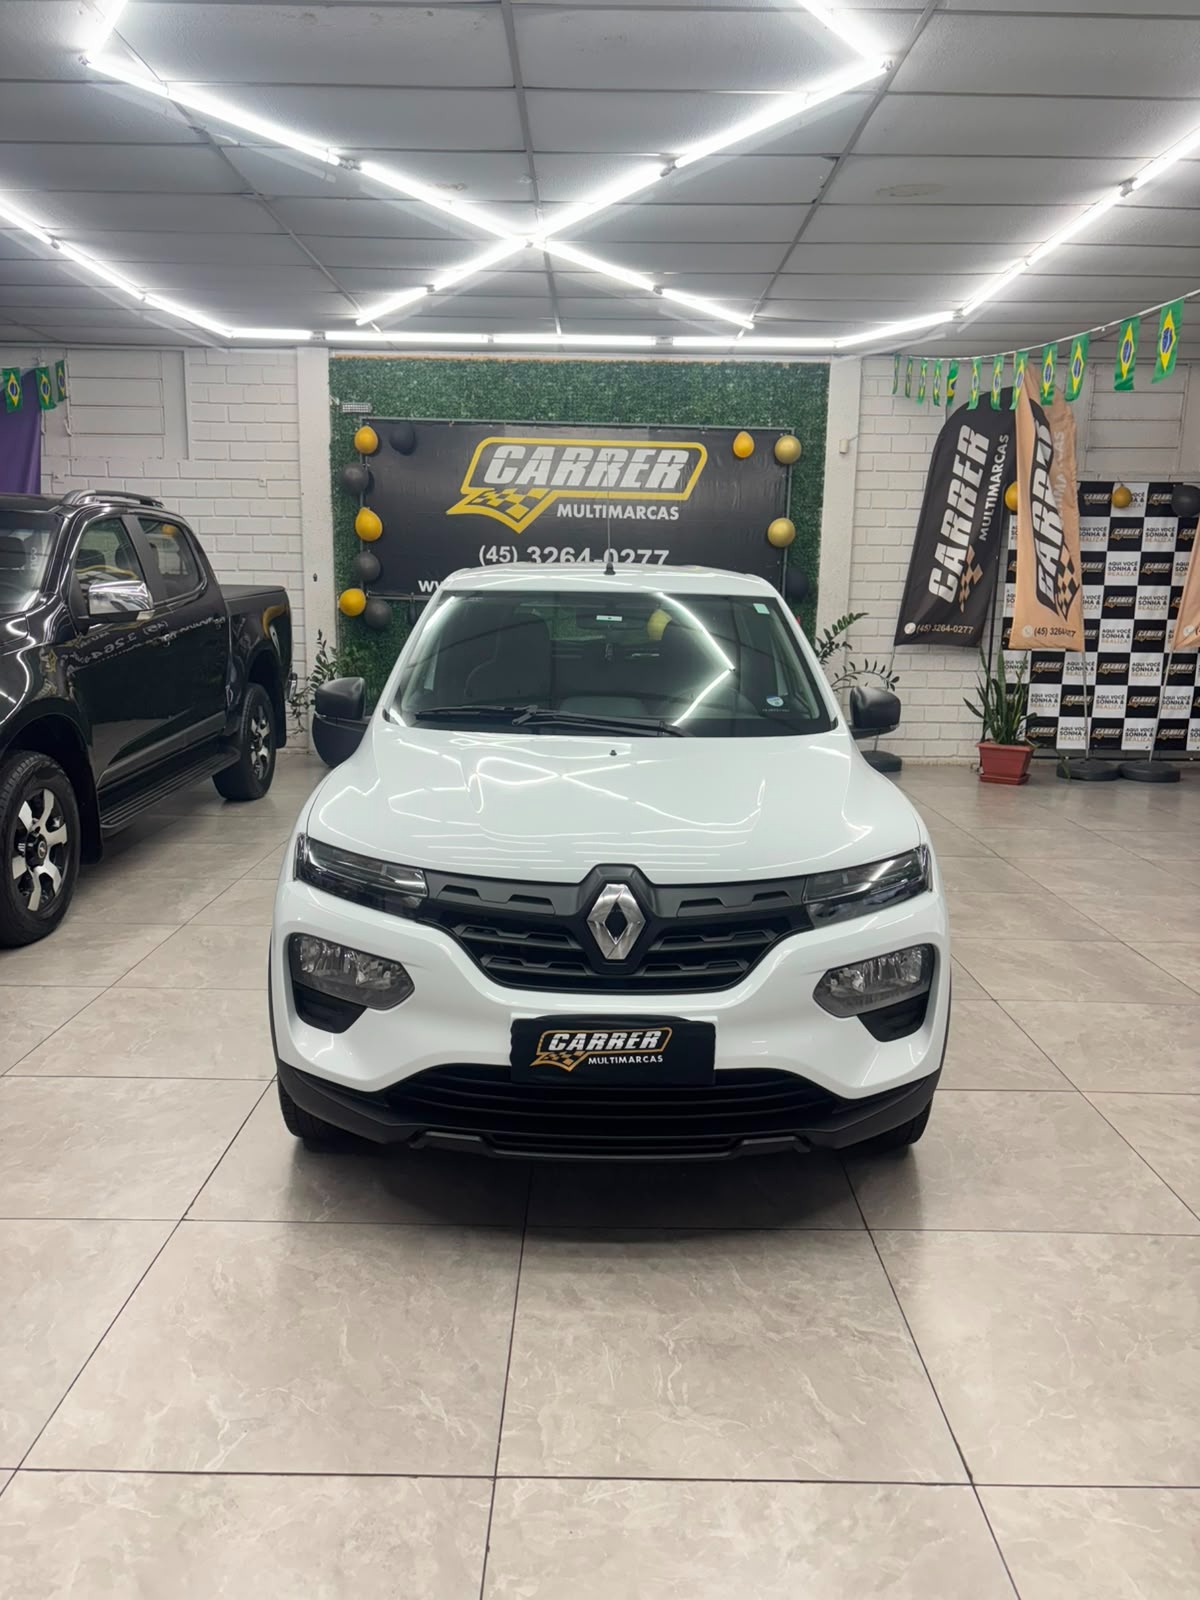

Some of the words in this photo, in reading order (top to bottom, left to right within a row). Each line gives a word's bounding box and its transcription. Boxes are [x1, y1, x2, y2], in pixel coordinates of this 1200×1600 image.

[483, 445, 690, 489] CARRER
[979, 434, 1010, 542] MULTIMARCAS
[556, 503, 680, 520] MULTIMARCAS
[928, 424, 990, 604] CARRER
[478, 545, 518, 567] (45)
[548, 1030, 662, 1051] CARRER
[588, 1055, 664, 1065] MULTIMARCAS
